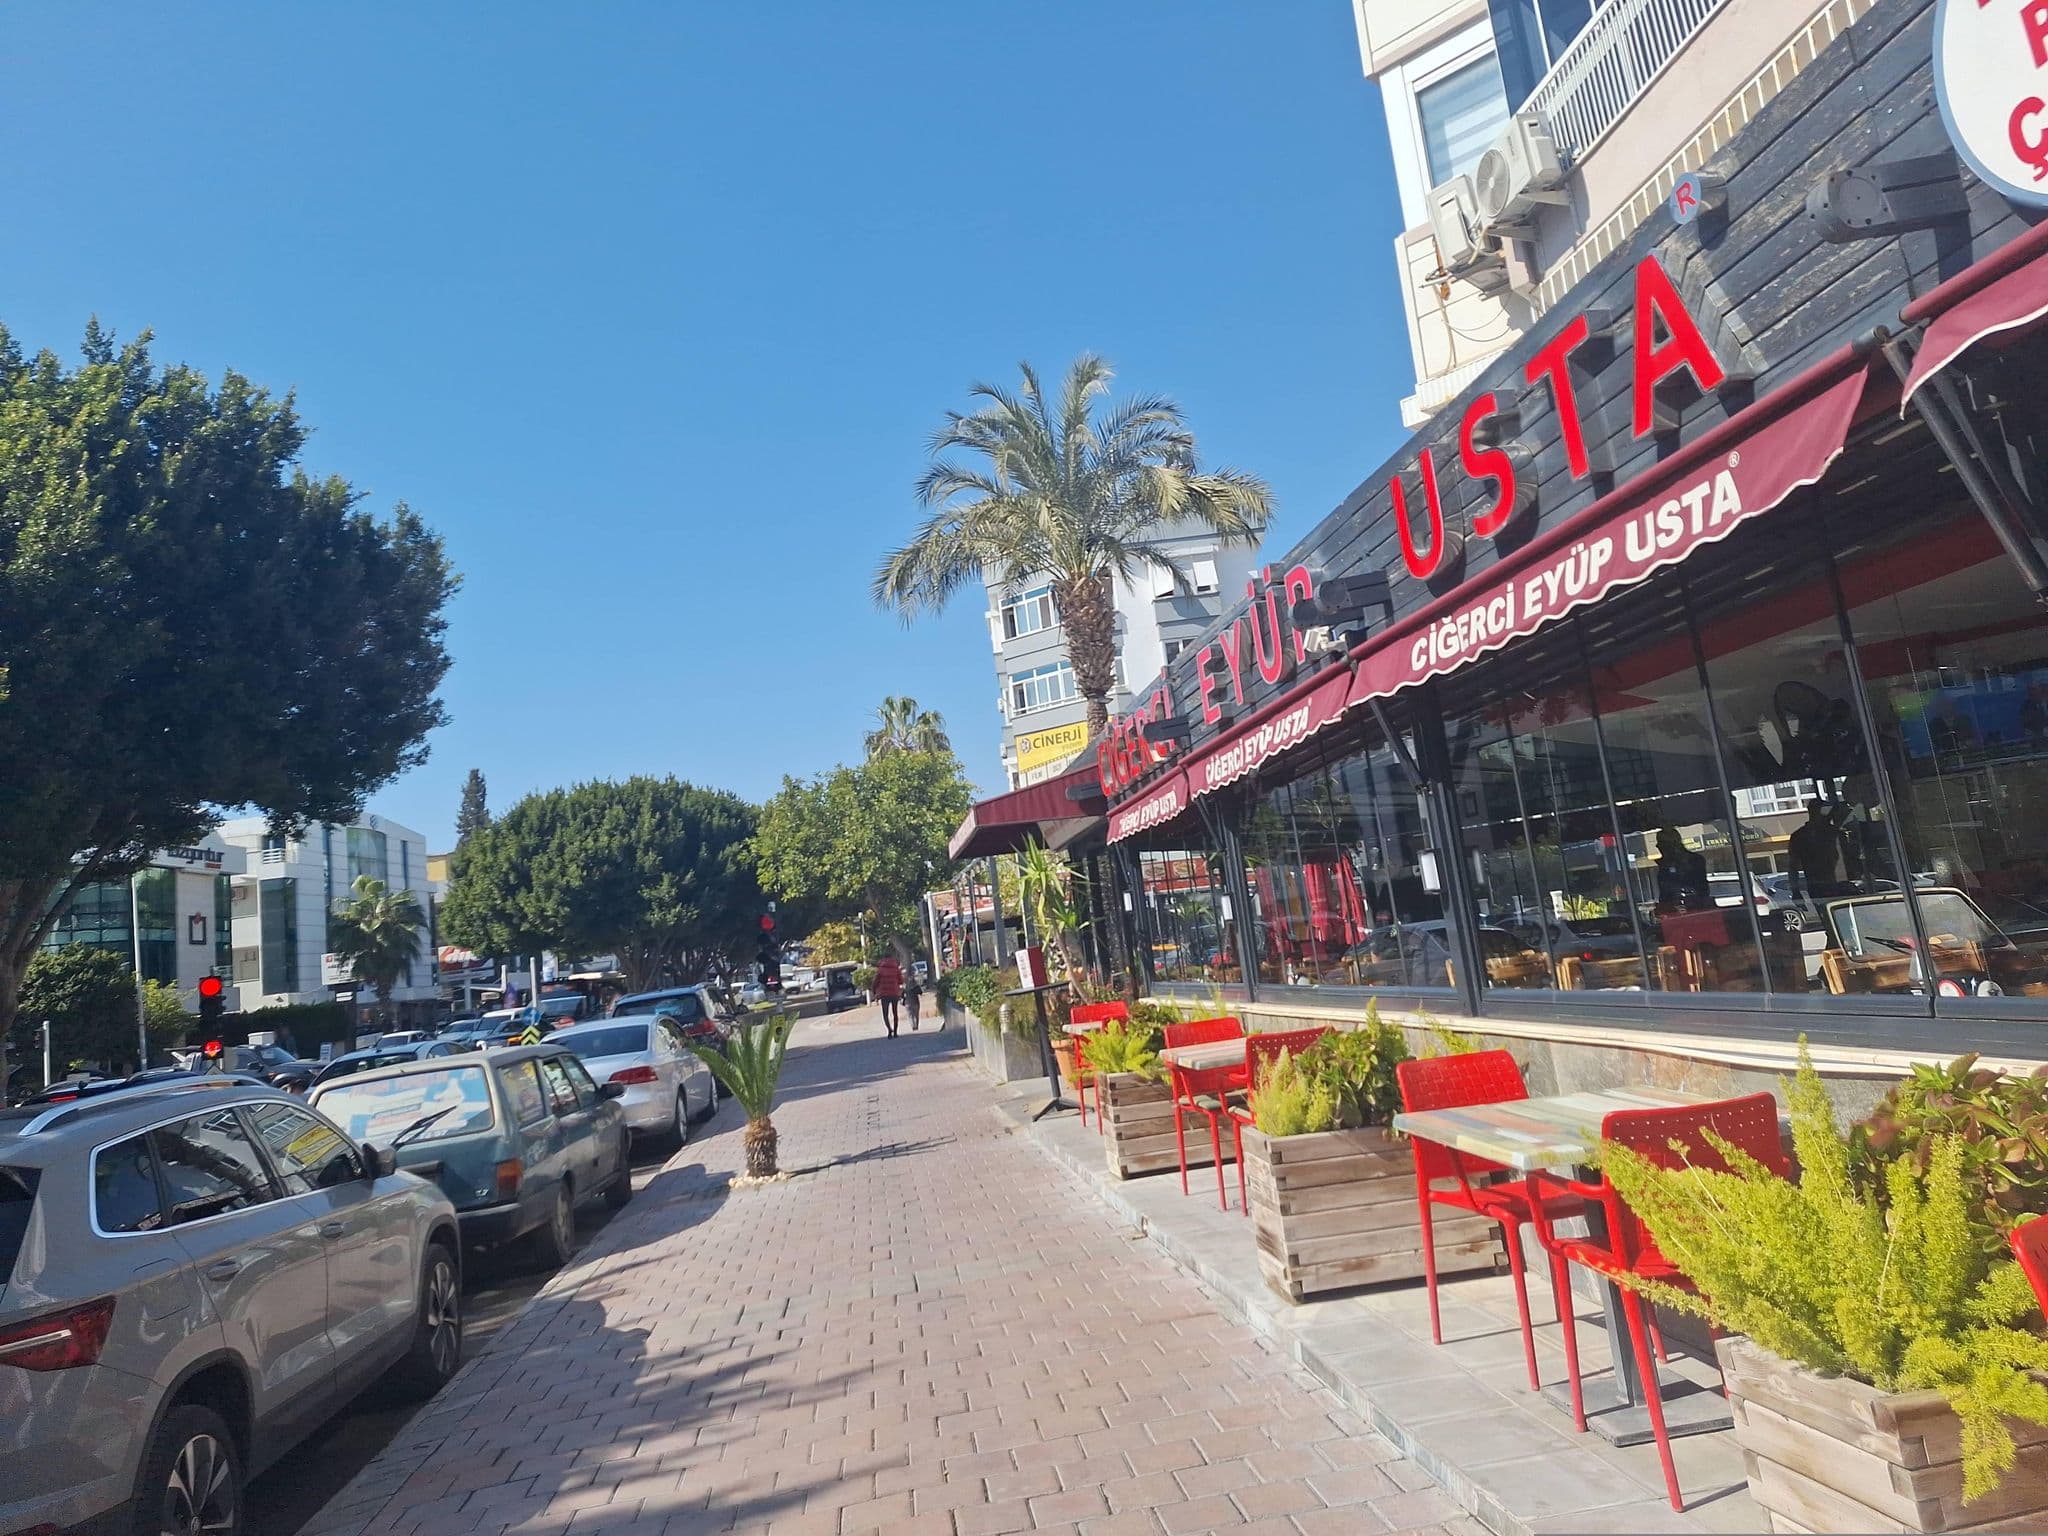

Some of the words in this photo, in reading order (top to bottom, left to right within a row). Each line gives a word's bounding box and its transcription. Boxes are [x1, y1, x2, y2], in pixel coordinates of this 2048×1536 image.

[1197, 565, 1313, 725] EYÜP
[1389, 253, 1726, 580] USTA
[1411, 582, 1515, 672] CİĞERCİ
[1523, 542, 1613, 620] EYÜP
[1625, 469, 1742, 562] USTA
[1032, 726, 1082, 749] CİNERJİ
[1244, 724, 1275, 763] EYÜP
[1273, 705, 1309, 744] USTA
